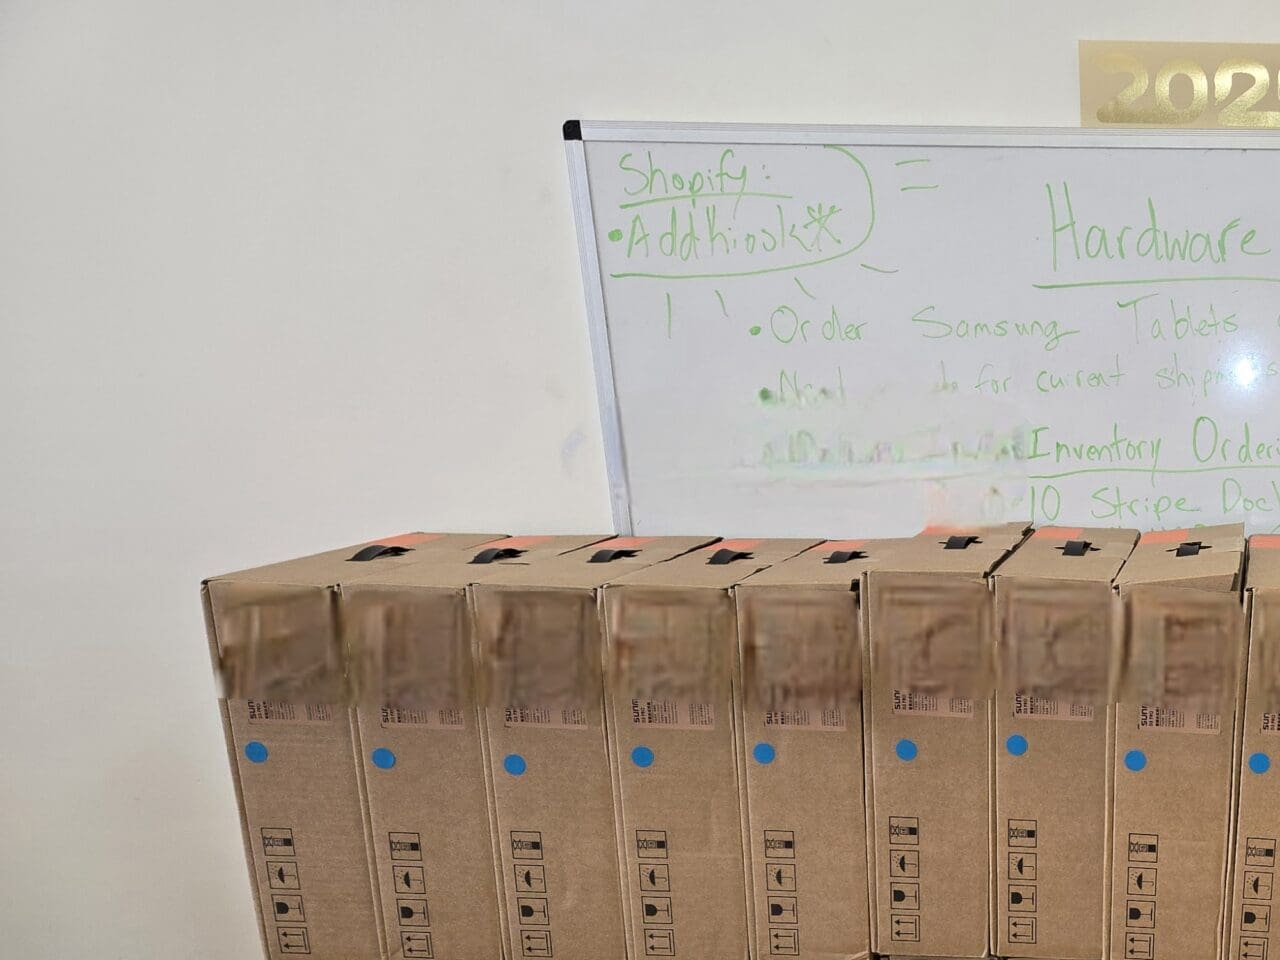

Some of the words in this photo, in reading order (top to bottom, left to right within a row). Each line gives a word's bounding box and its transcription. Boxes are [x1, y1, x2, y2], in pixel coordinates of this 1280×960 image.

[1046, 181, 1272, 272] Hardware
[770, 305, 868, 343] Order
[911, 306, 1080, 351] Samsung
[1117, 293, 1238, 344] Tablets
[974, 363, 1012, 394] for
[1027, 422, 1162, 488] Inventory
[1029, 485, 1061, 521] 10
[1091, 486, 1200, 522] Stripe
